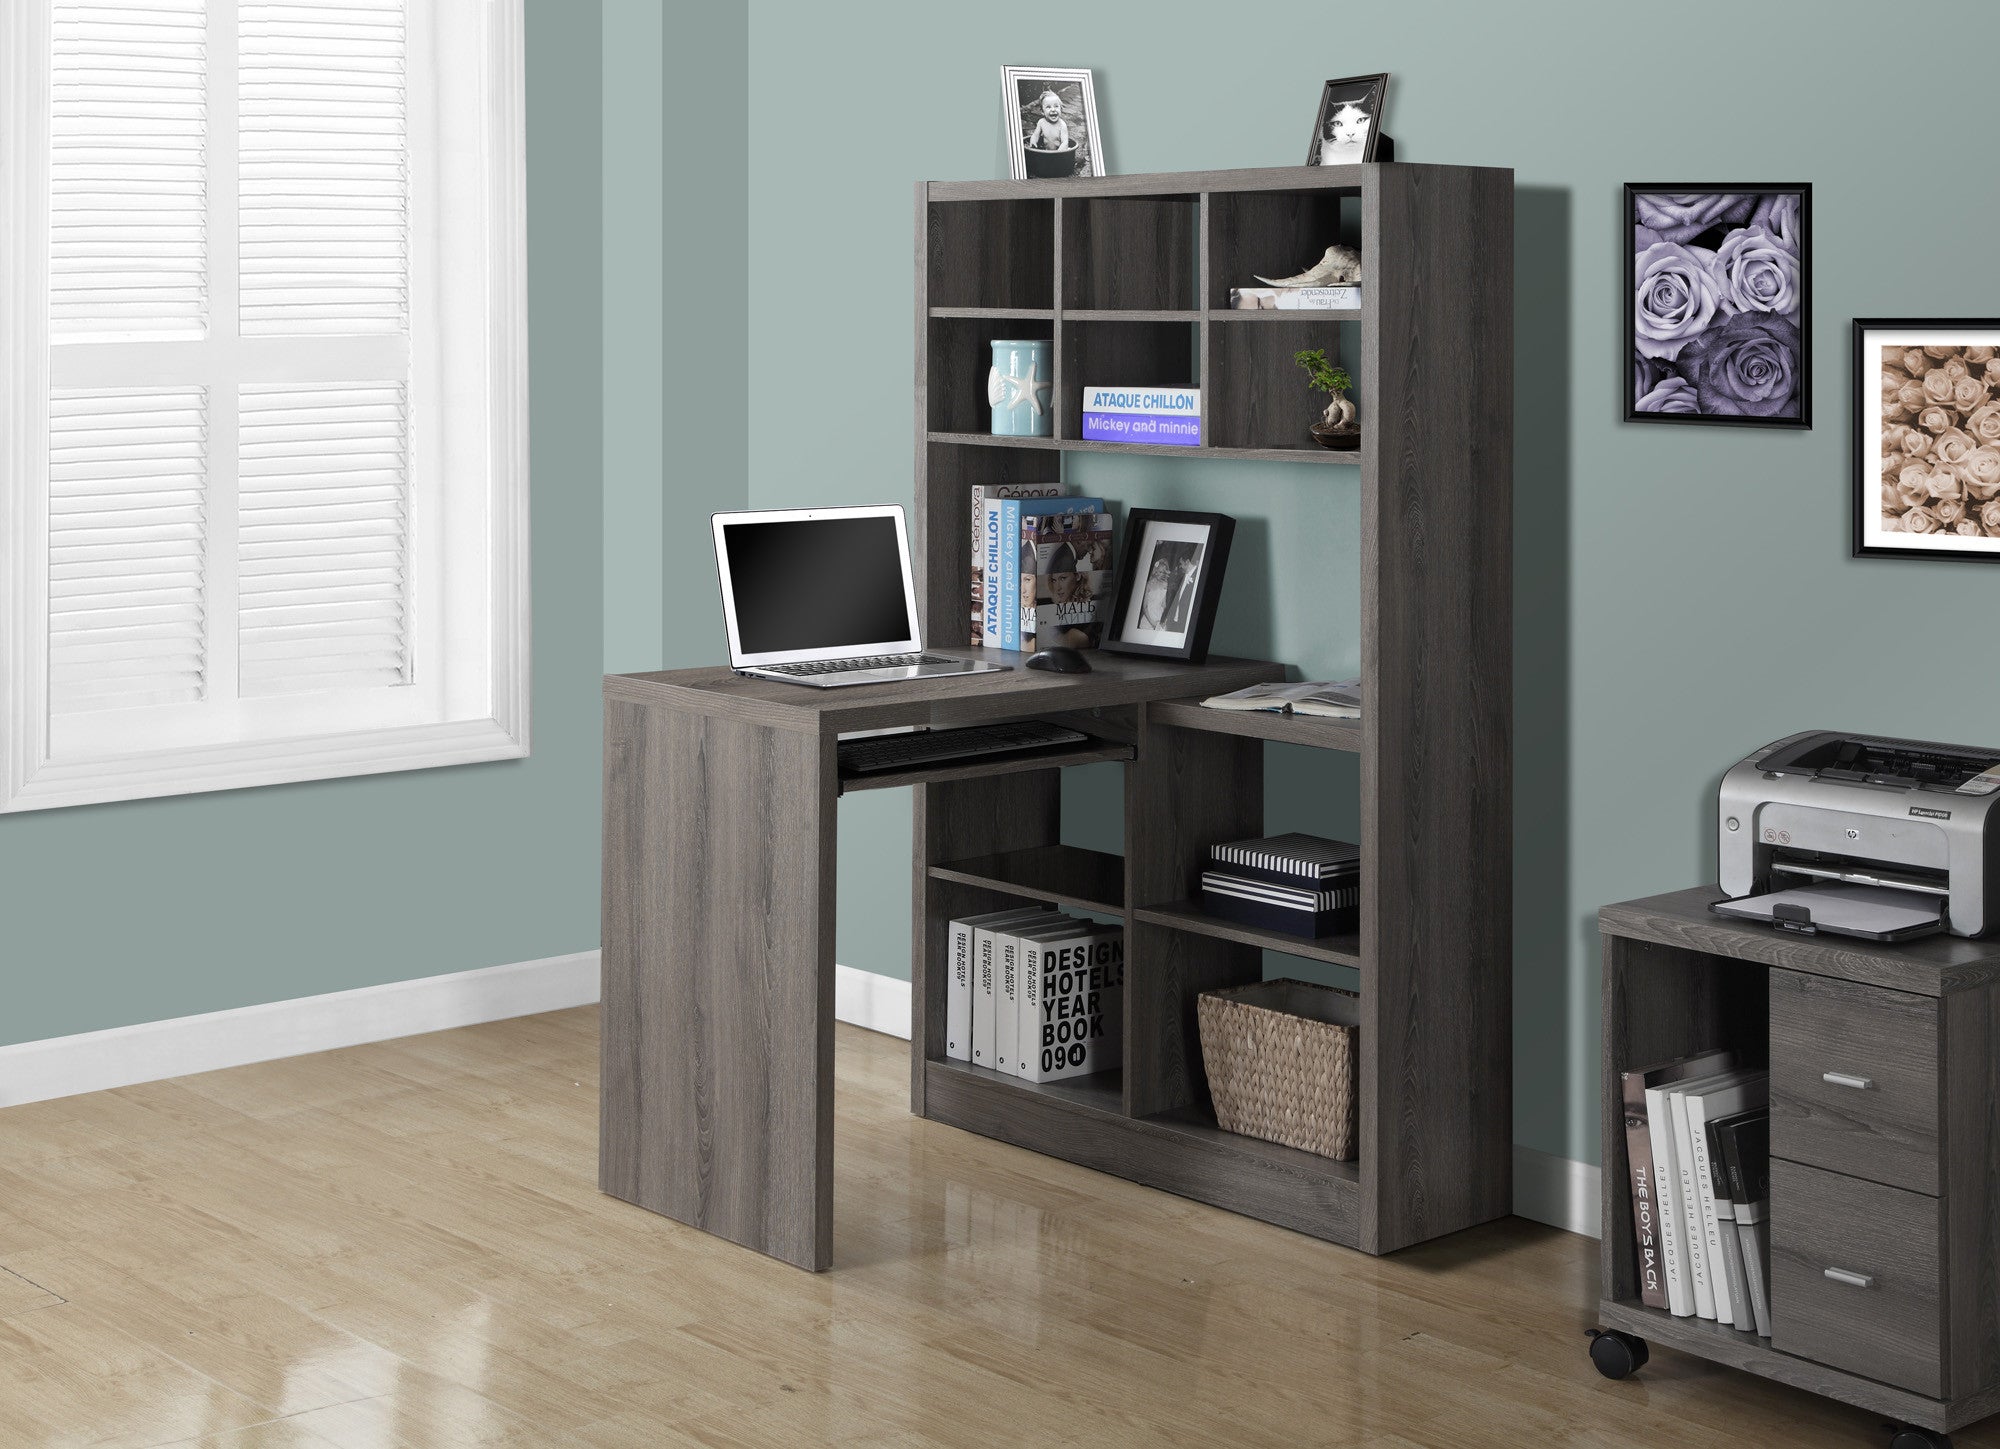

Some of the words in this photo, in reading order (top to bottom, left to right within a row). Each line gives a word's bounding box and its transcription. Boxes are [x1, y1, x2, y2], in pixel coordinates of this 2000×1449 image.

[1093, 392, 1142, 409] ATAQUE
[1143, 394, 1194, 410] CHILLÓN
[1088, 417, 1130, 434] Mickey
[1132, 420, 1157, 433] and
[1159, 421, 1199, 435] minnie
[973, 486, 982, 553] Génova
[988, 510, 999, 573] CHILLÓN
[1004, 506, 1015, 559] Mickey
[1003, 561, 1015, 593] and
[987, 576, 998, 635] ATAQUE
[1003, 594, 1013, 644] minnie
[1056, 601, 1096, 616] МАТЬ
[1044, 941, 1124, 973] DESIGN
[1043, 991, 1101, 1022] YEAR
[1043, 1014, 1105, 1047] BOOK
[1041, 1046, 1066, 1073] 09
[1636, 1167, 1648, 1199] THE
[1659, 1166, 1669, 1215] HELLEU
[1682, 1170, 1694, 1219] HELLEU
[1694, 1129, 1708, 1189] JACQUES
[1703, 1196, 1716, 1246] HELLEU
[1640, 1201, 1653, 1246] BOYS
[1644, 1248, 1658, 1290] BACK
[1665, 1222, 1677, 1282] JACQUES
[1690, 1225, 1704, 1285] JACQUES
